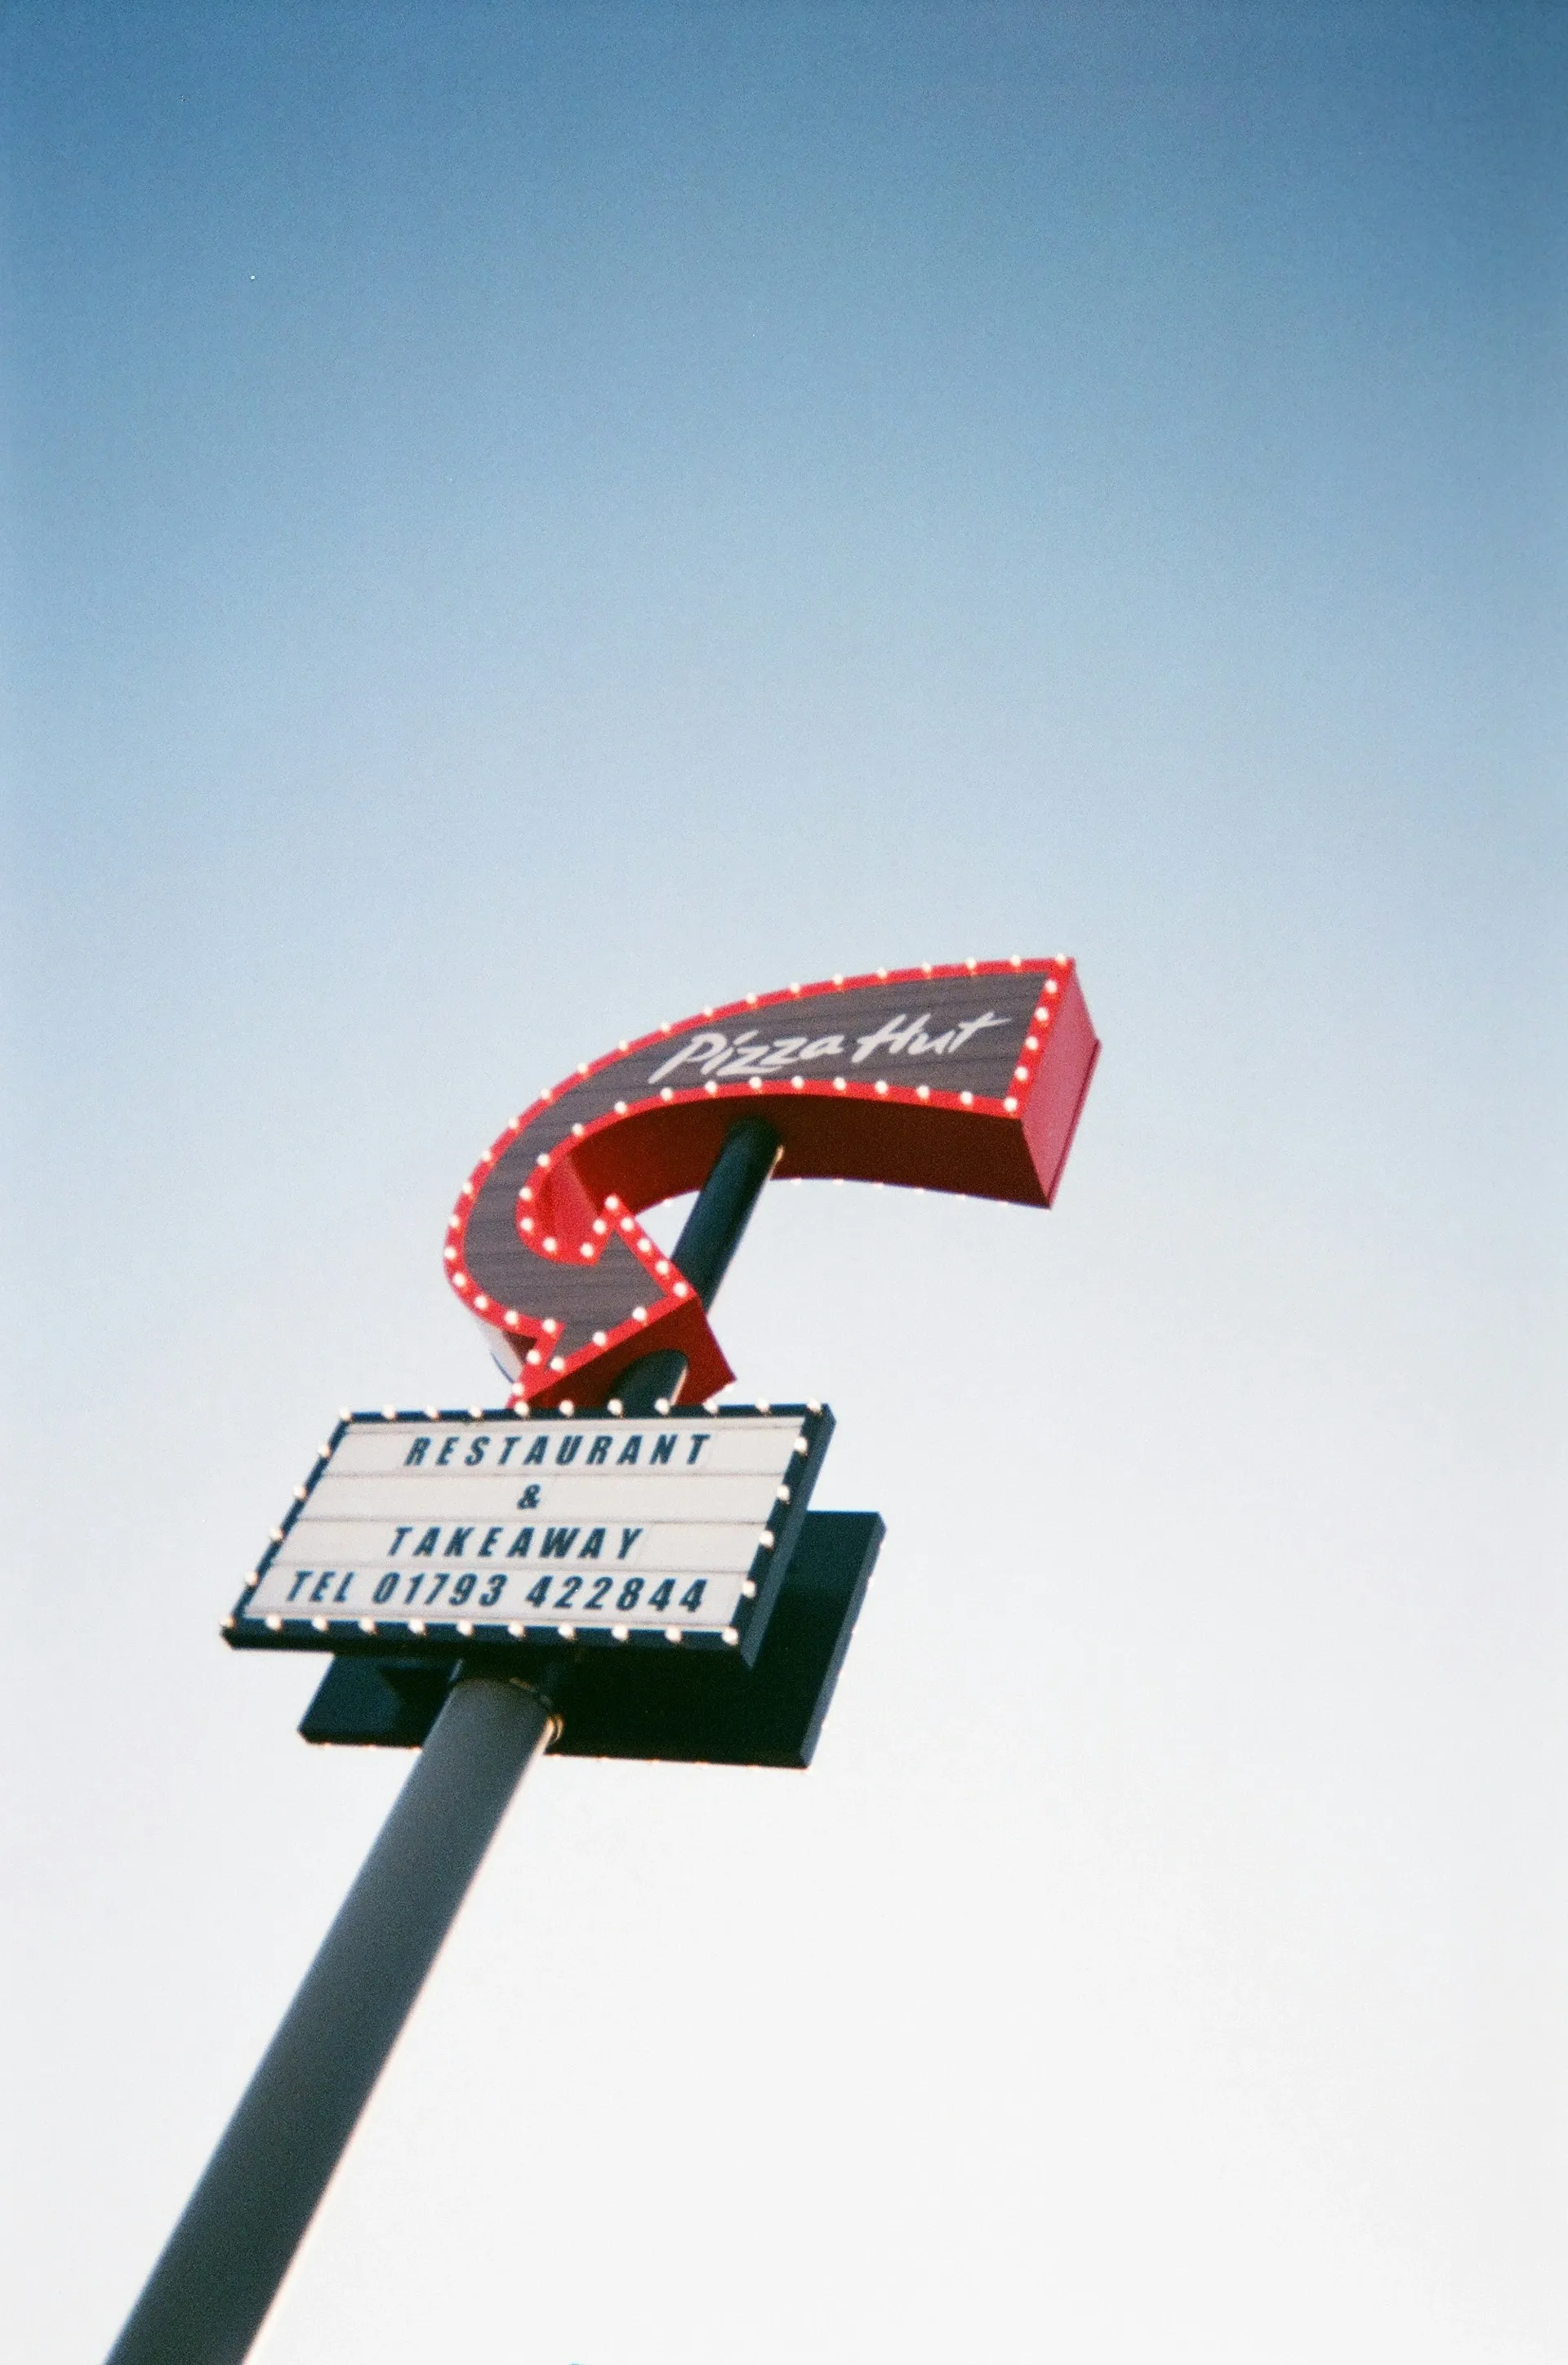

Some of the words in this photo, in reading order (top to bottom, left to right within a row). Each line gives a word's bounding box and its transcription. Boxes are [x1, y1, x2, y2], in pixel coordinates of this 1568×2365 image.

[648, 1030, 844, 1084] Pizza
[852, 1012, 1012, 1063] Hut
[405, 1434, 710, 1467] RESTAURANT
[517, 1484, 541, 1510] &
[387, 1527, 643, 1560] TAKEAWAY
[286, 1570, 355, 1602] TEL
[372, 1572, 506, 1607] 01793
[526, 1574, 709, 1613] 422844
